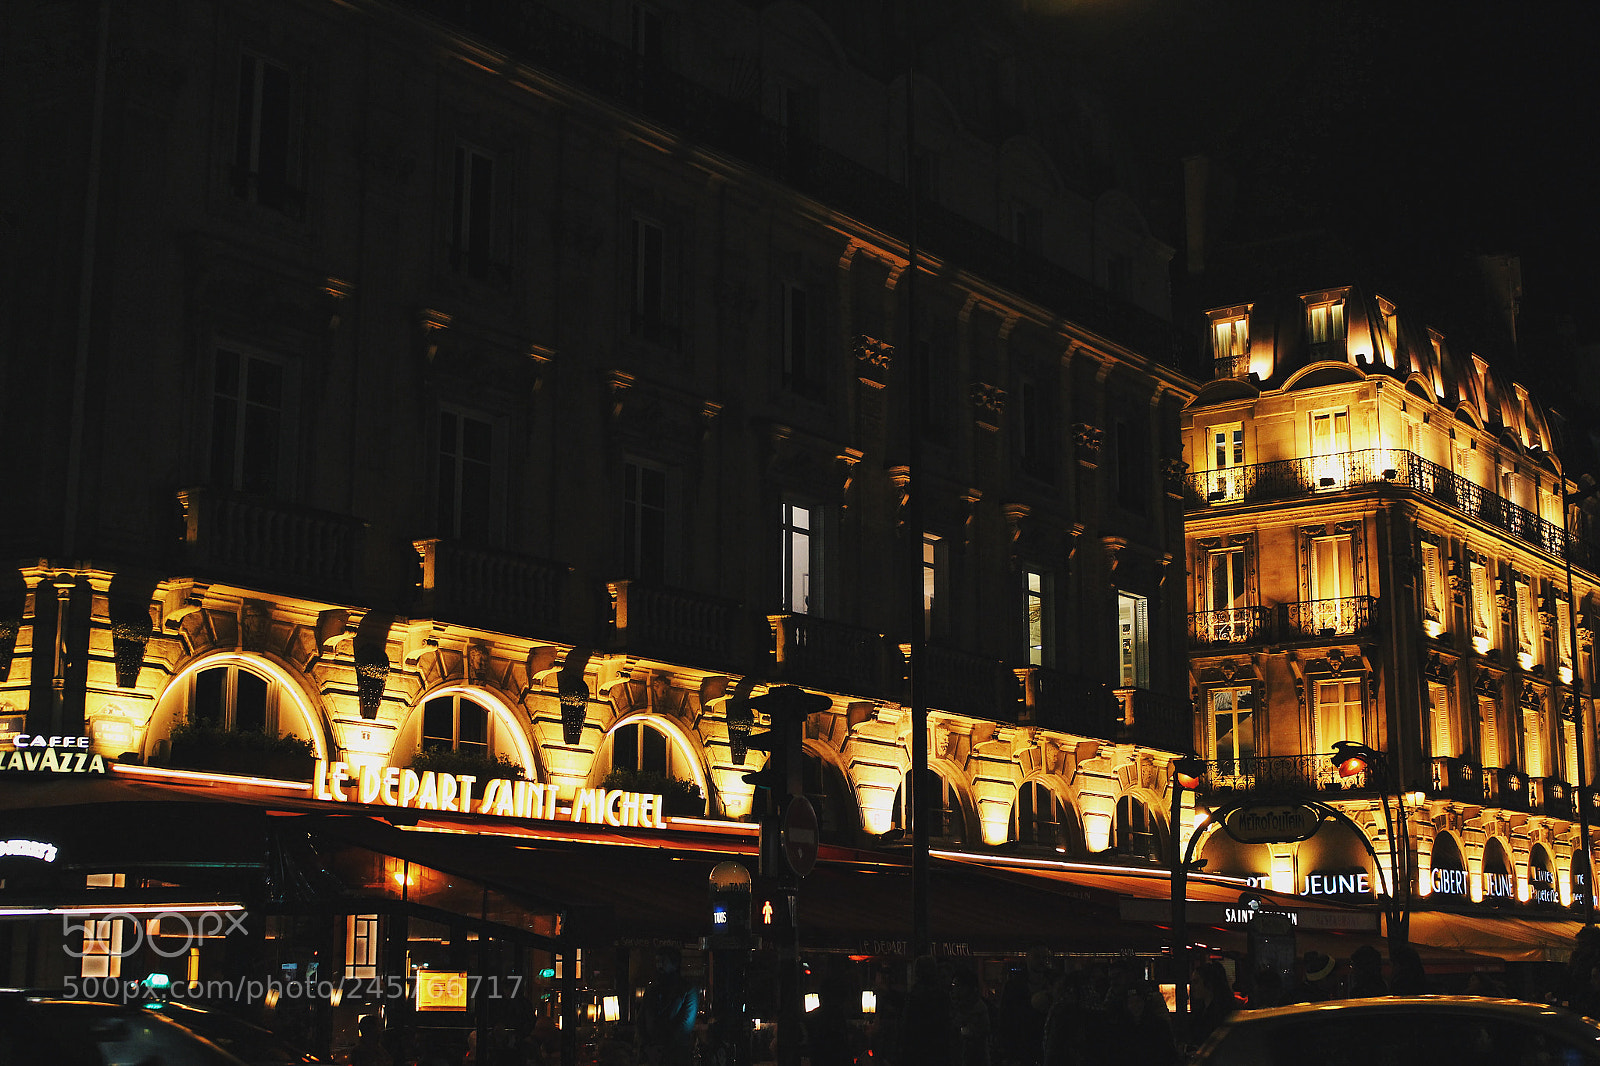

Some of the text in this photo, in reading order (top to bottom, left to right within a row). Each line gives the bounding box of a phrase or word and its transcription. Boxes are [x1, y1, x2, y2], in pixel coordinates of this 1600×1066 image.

[13, 734, 90, 748] CAFFE
[0, 747, 106, 774] LAVAZZA
[312, 759, 349, 802] LE
[358, 765, 477, 814] DEPART
[1300, 873, 1370, 896] JEUNE
[1430, 867, 1515, 898] GIBERT JEUNE
[1225, 908, 1254, 924] SAINT
